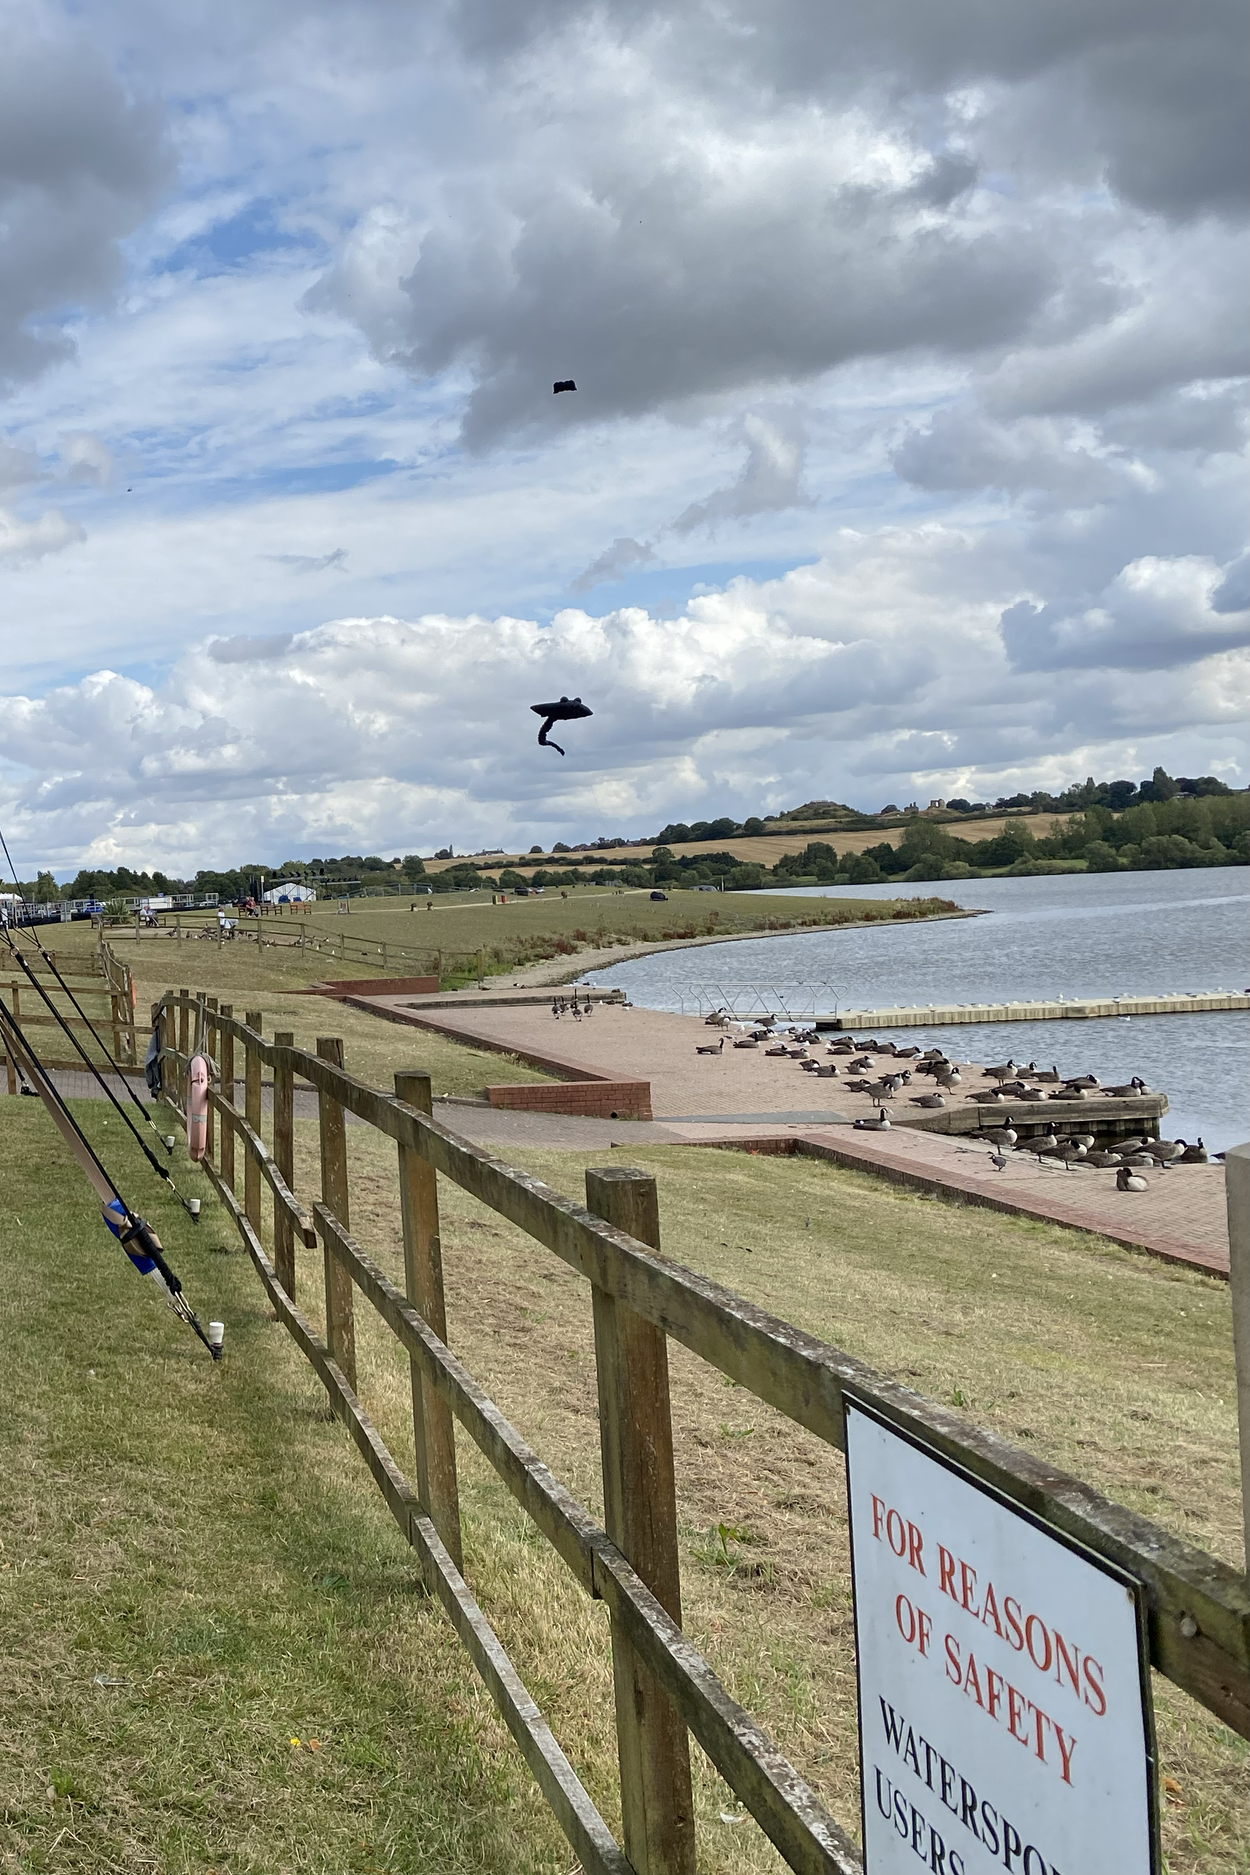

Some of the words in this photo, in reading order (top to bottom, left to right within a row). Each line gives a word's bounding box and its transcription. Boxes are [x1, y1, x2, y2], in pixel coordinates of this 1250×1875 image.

[870, 1493, 927, 1577] FOR
[937, 1543, 1107, 1717] REASONS
[895, 1594, 933, 1658] OF
[944, 1633, 1078, 1788] SAFETY
[878, 1694, 1063, 1875] WATERSPO
